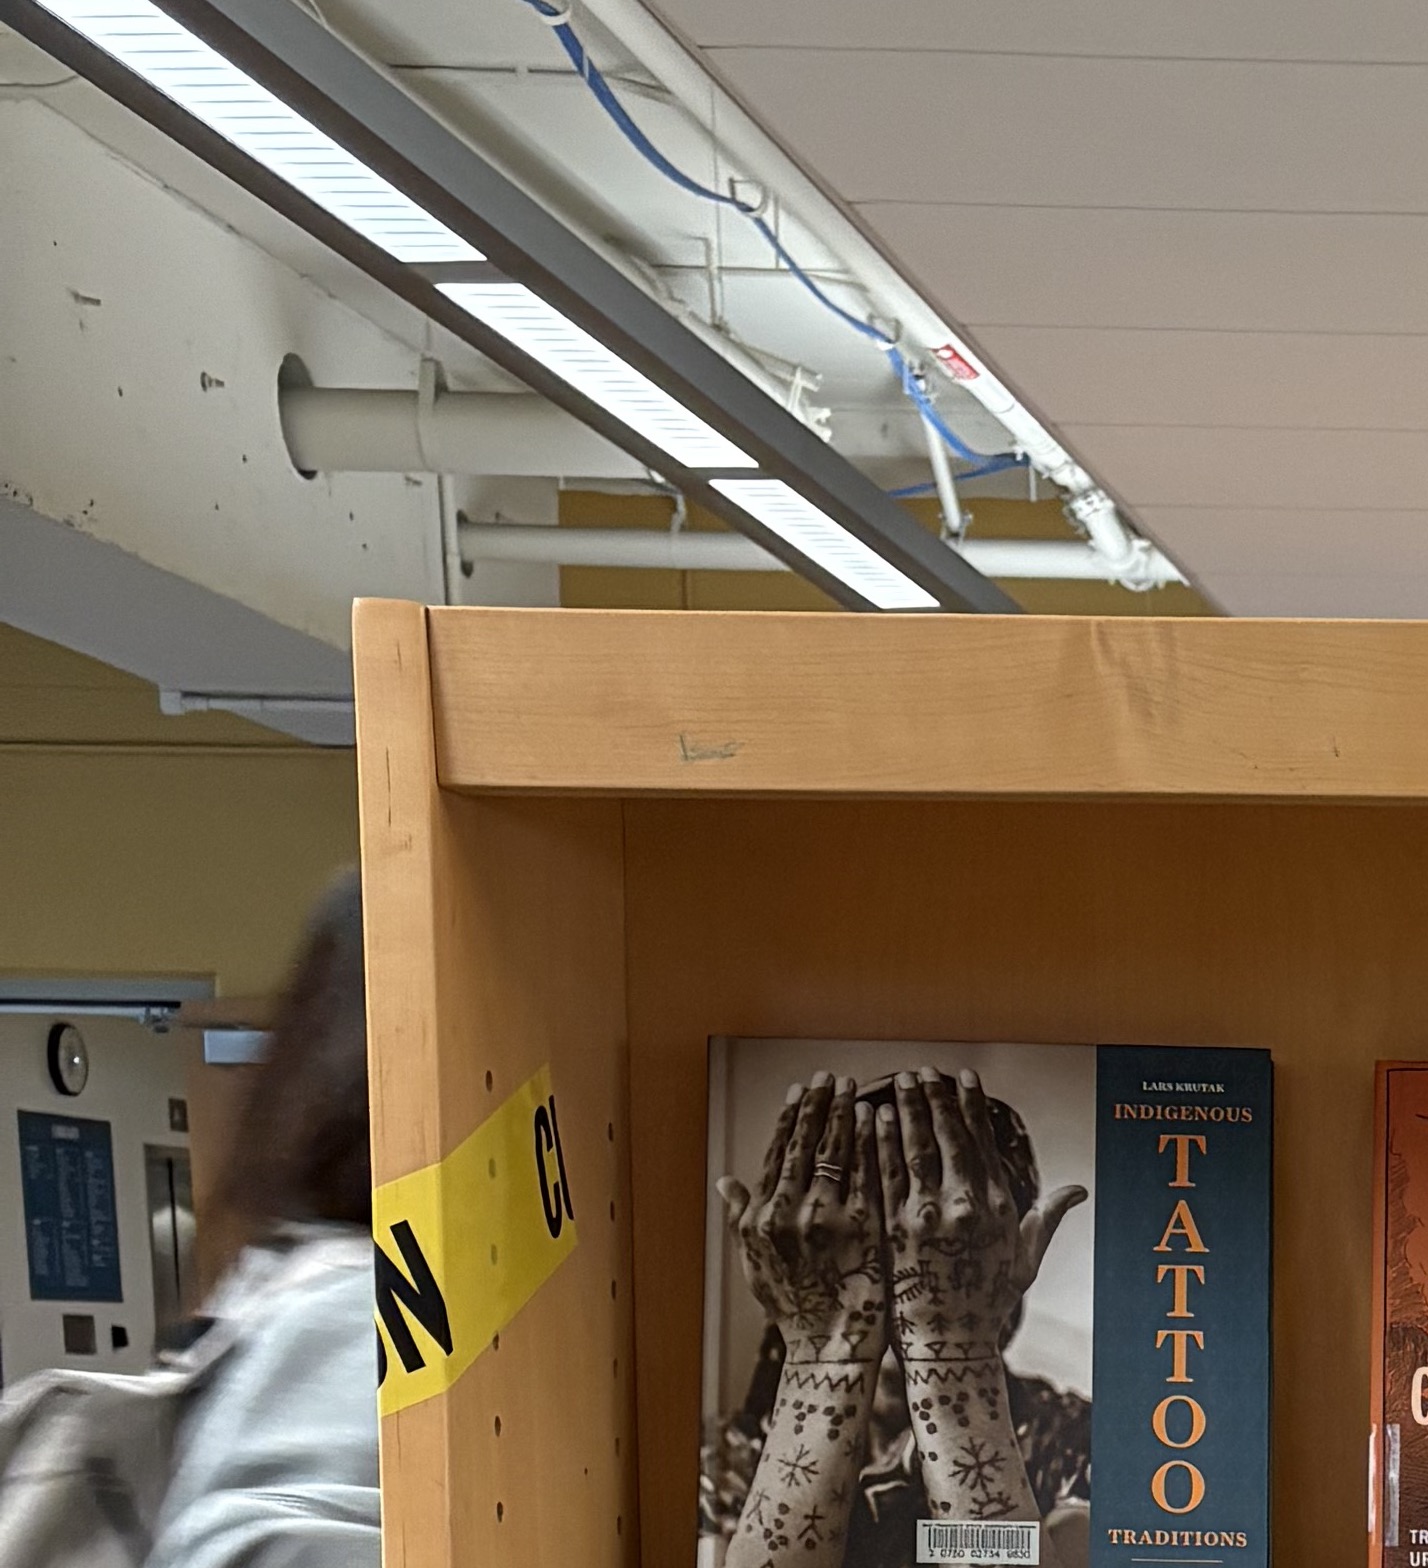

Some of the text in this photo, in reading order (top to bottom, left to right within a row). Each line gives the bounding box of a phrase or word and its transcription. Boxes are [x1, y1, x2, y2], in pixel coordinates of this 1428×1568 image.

[1114, 1104, 1252, 1122] INDIGENOUS
[1150, 1135, 1208, 1514] TATTOO
[1108, 1529, 1247, 1547] TRADITIONS
